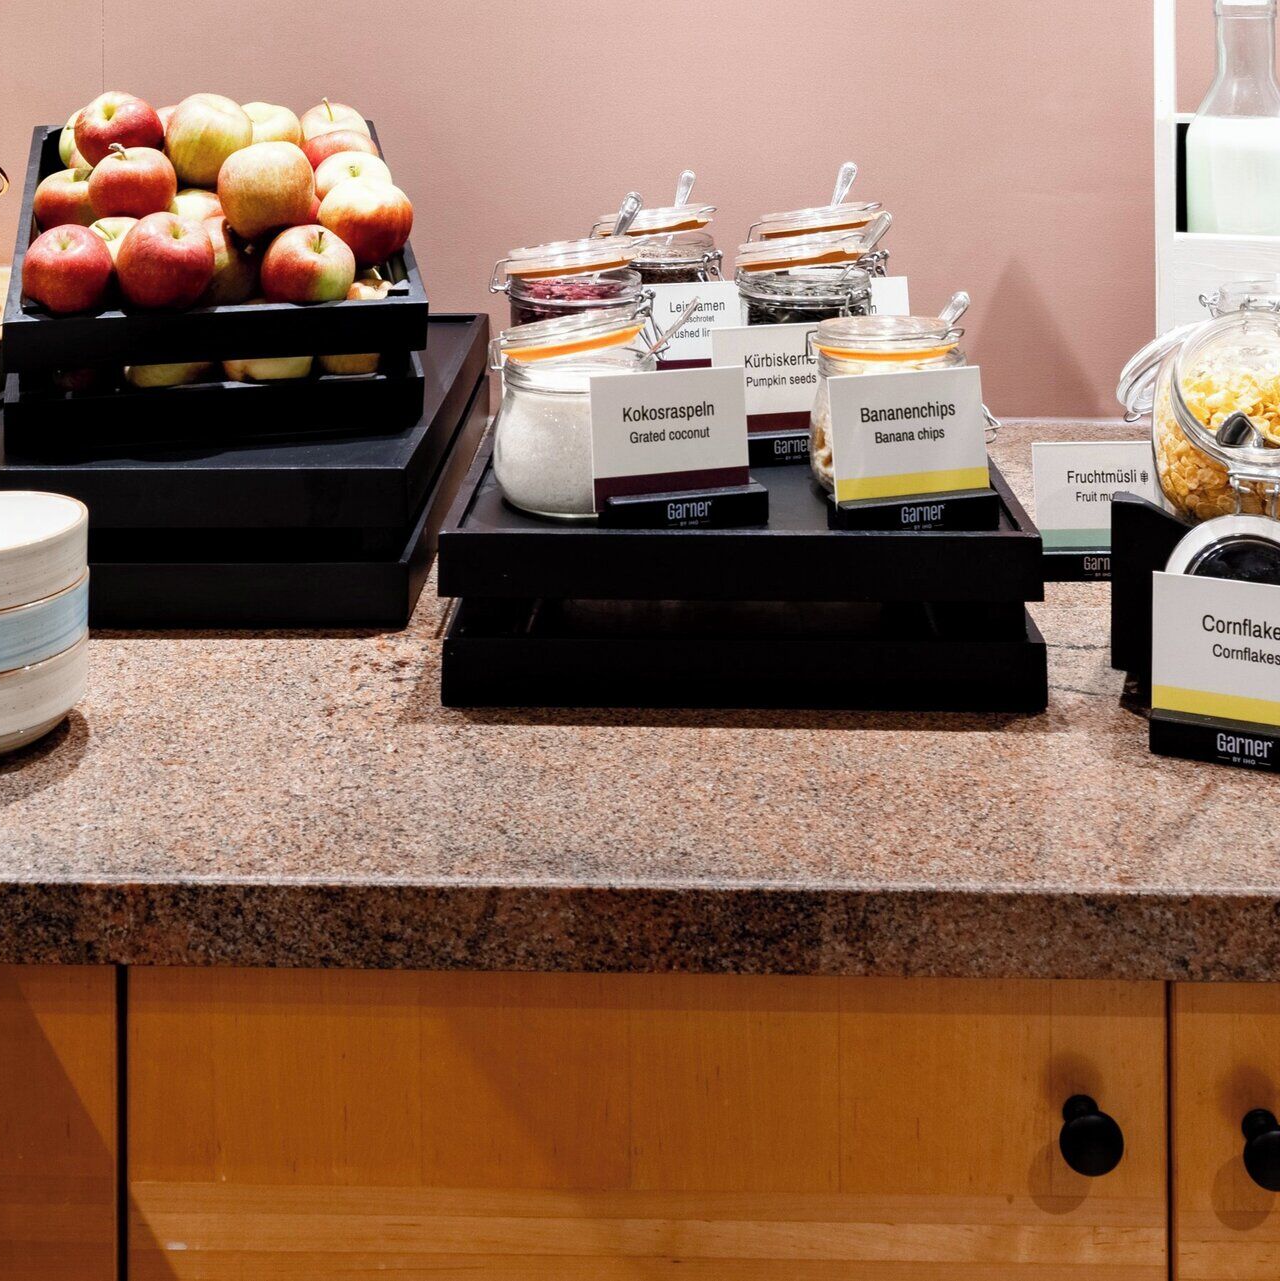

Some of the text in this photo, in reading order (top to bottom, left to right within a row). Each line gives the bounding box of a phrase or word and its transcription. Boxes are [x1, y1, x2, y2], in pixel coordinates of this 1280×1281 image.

[670, 301, 725, 313] Leiamen
[746, 373, 817, 388] Pumpkin seeds
[623, 401, 714, 422] Kokosraspeln
[860, 401, 956, 423] Bananenchips
[630, 426, 710, 444] Grated coconut
[875, 427, 945, 444] Banana chips
[1067, 469, 1137, 484] Fruchtmüsli
[1076, 491, 1098, 502] Fruit
[667, 500, 712, 520] Garner
[901, 504, 945, 524] Garner
[1083, 556, 1111, 571] Garn
[1216, 732, 1273, 758] Garner
